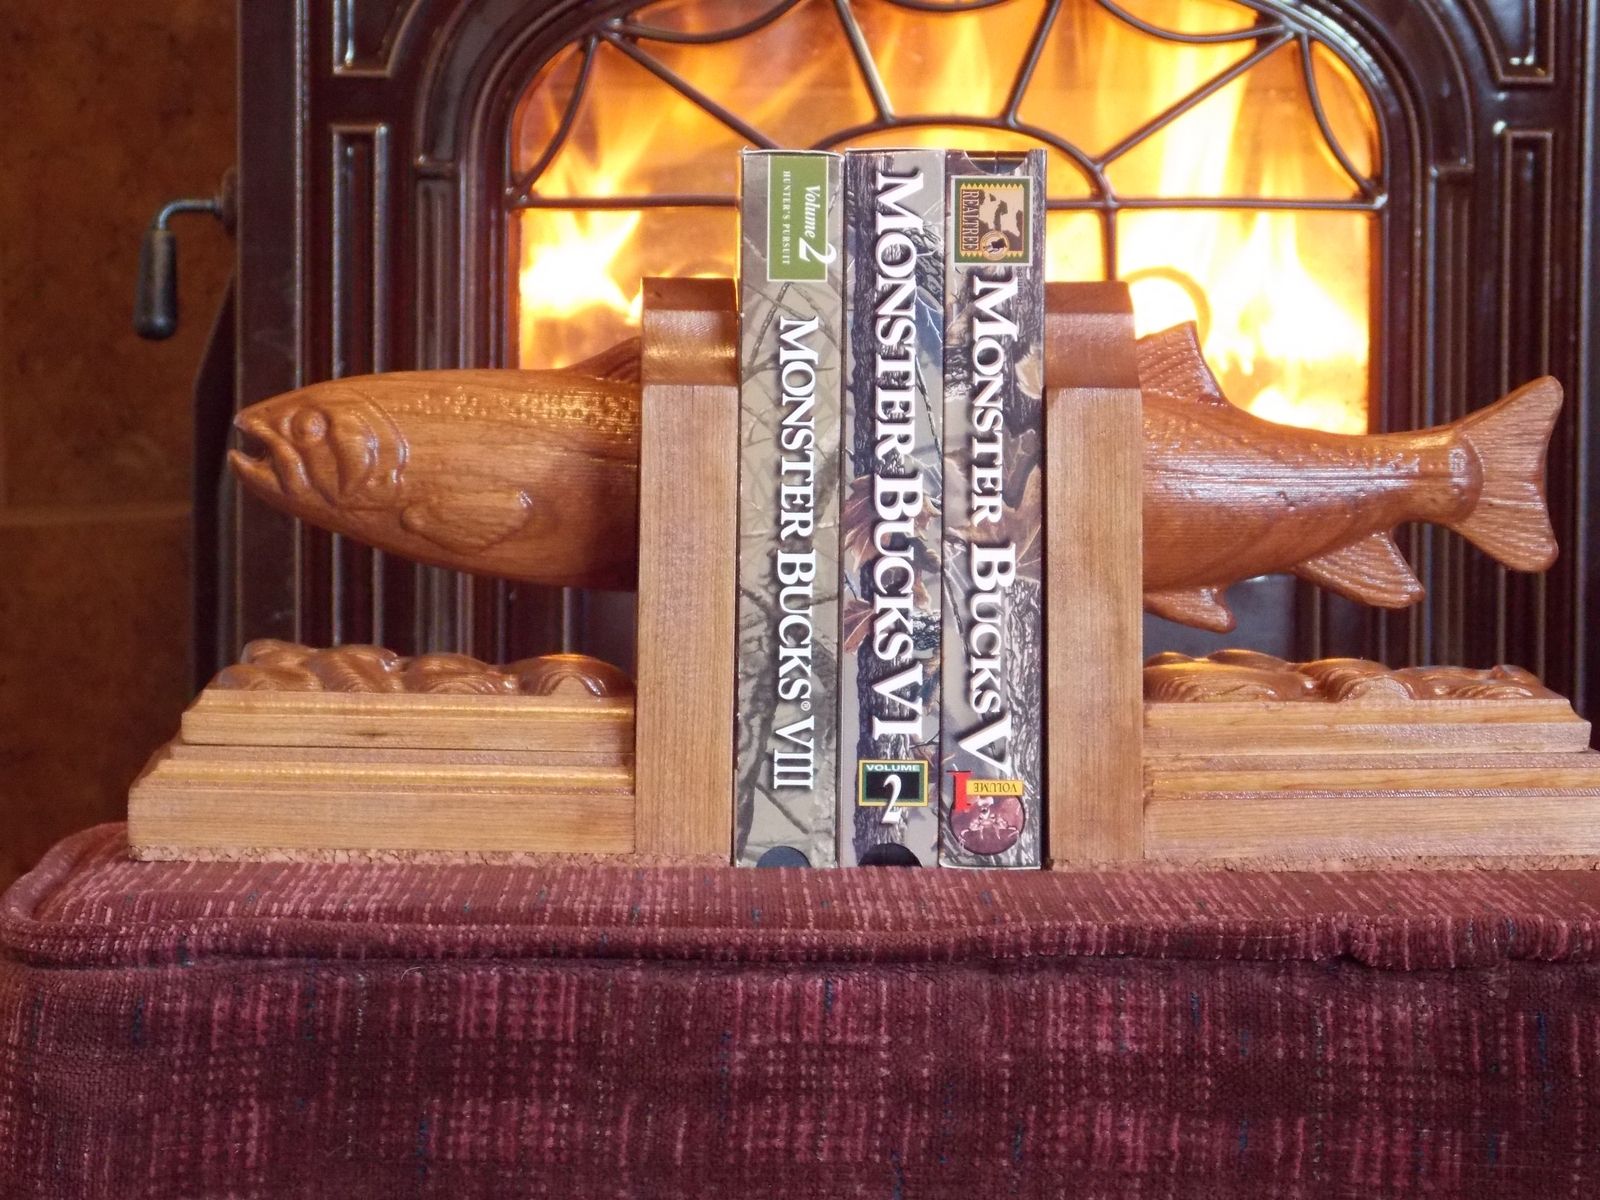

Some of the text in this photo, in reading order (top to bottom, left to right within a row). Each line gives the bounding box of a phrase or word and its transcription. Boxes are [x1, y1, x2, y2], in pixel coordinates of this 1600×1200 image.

[782, 171, 791, 265] HUNTER'S PURSUIT
[798, 185, 837, 264] Volume 2
[961, 188, 981, 252] REALTREE
[778, 315, 819, 541] MONSTER
[871, 166, 925, 741] MONSTER BUCKS VI
[958, 274, 1019, 777] MONSTER BUCKS V
[773, 715, 815, 790] VIII
[865, 764, 921, 772] VOLUME
[973, 782, 1018, 793] VOLUME
[881, 773, 903, 824] 2
